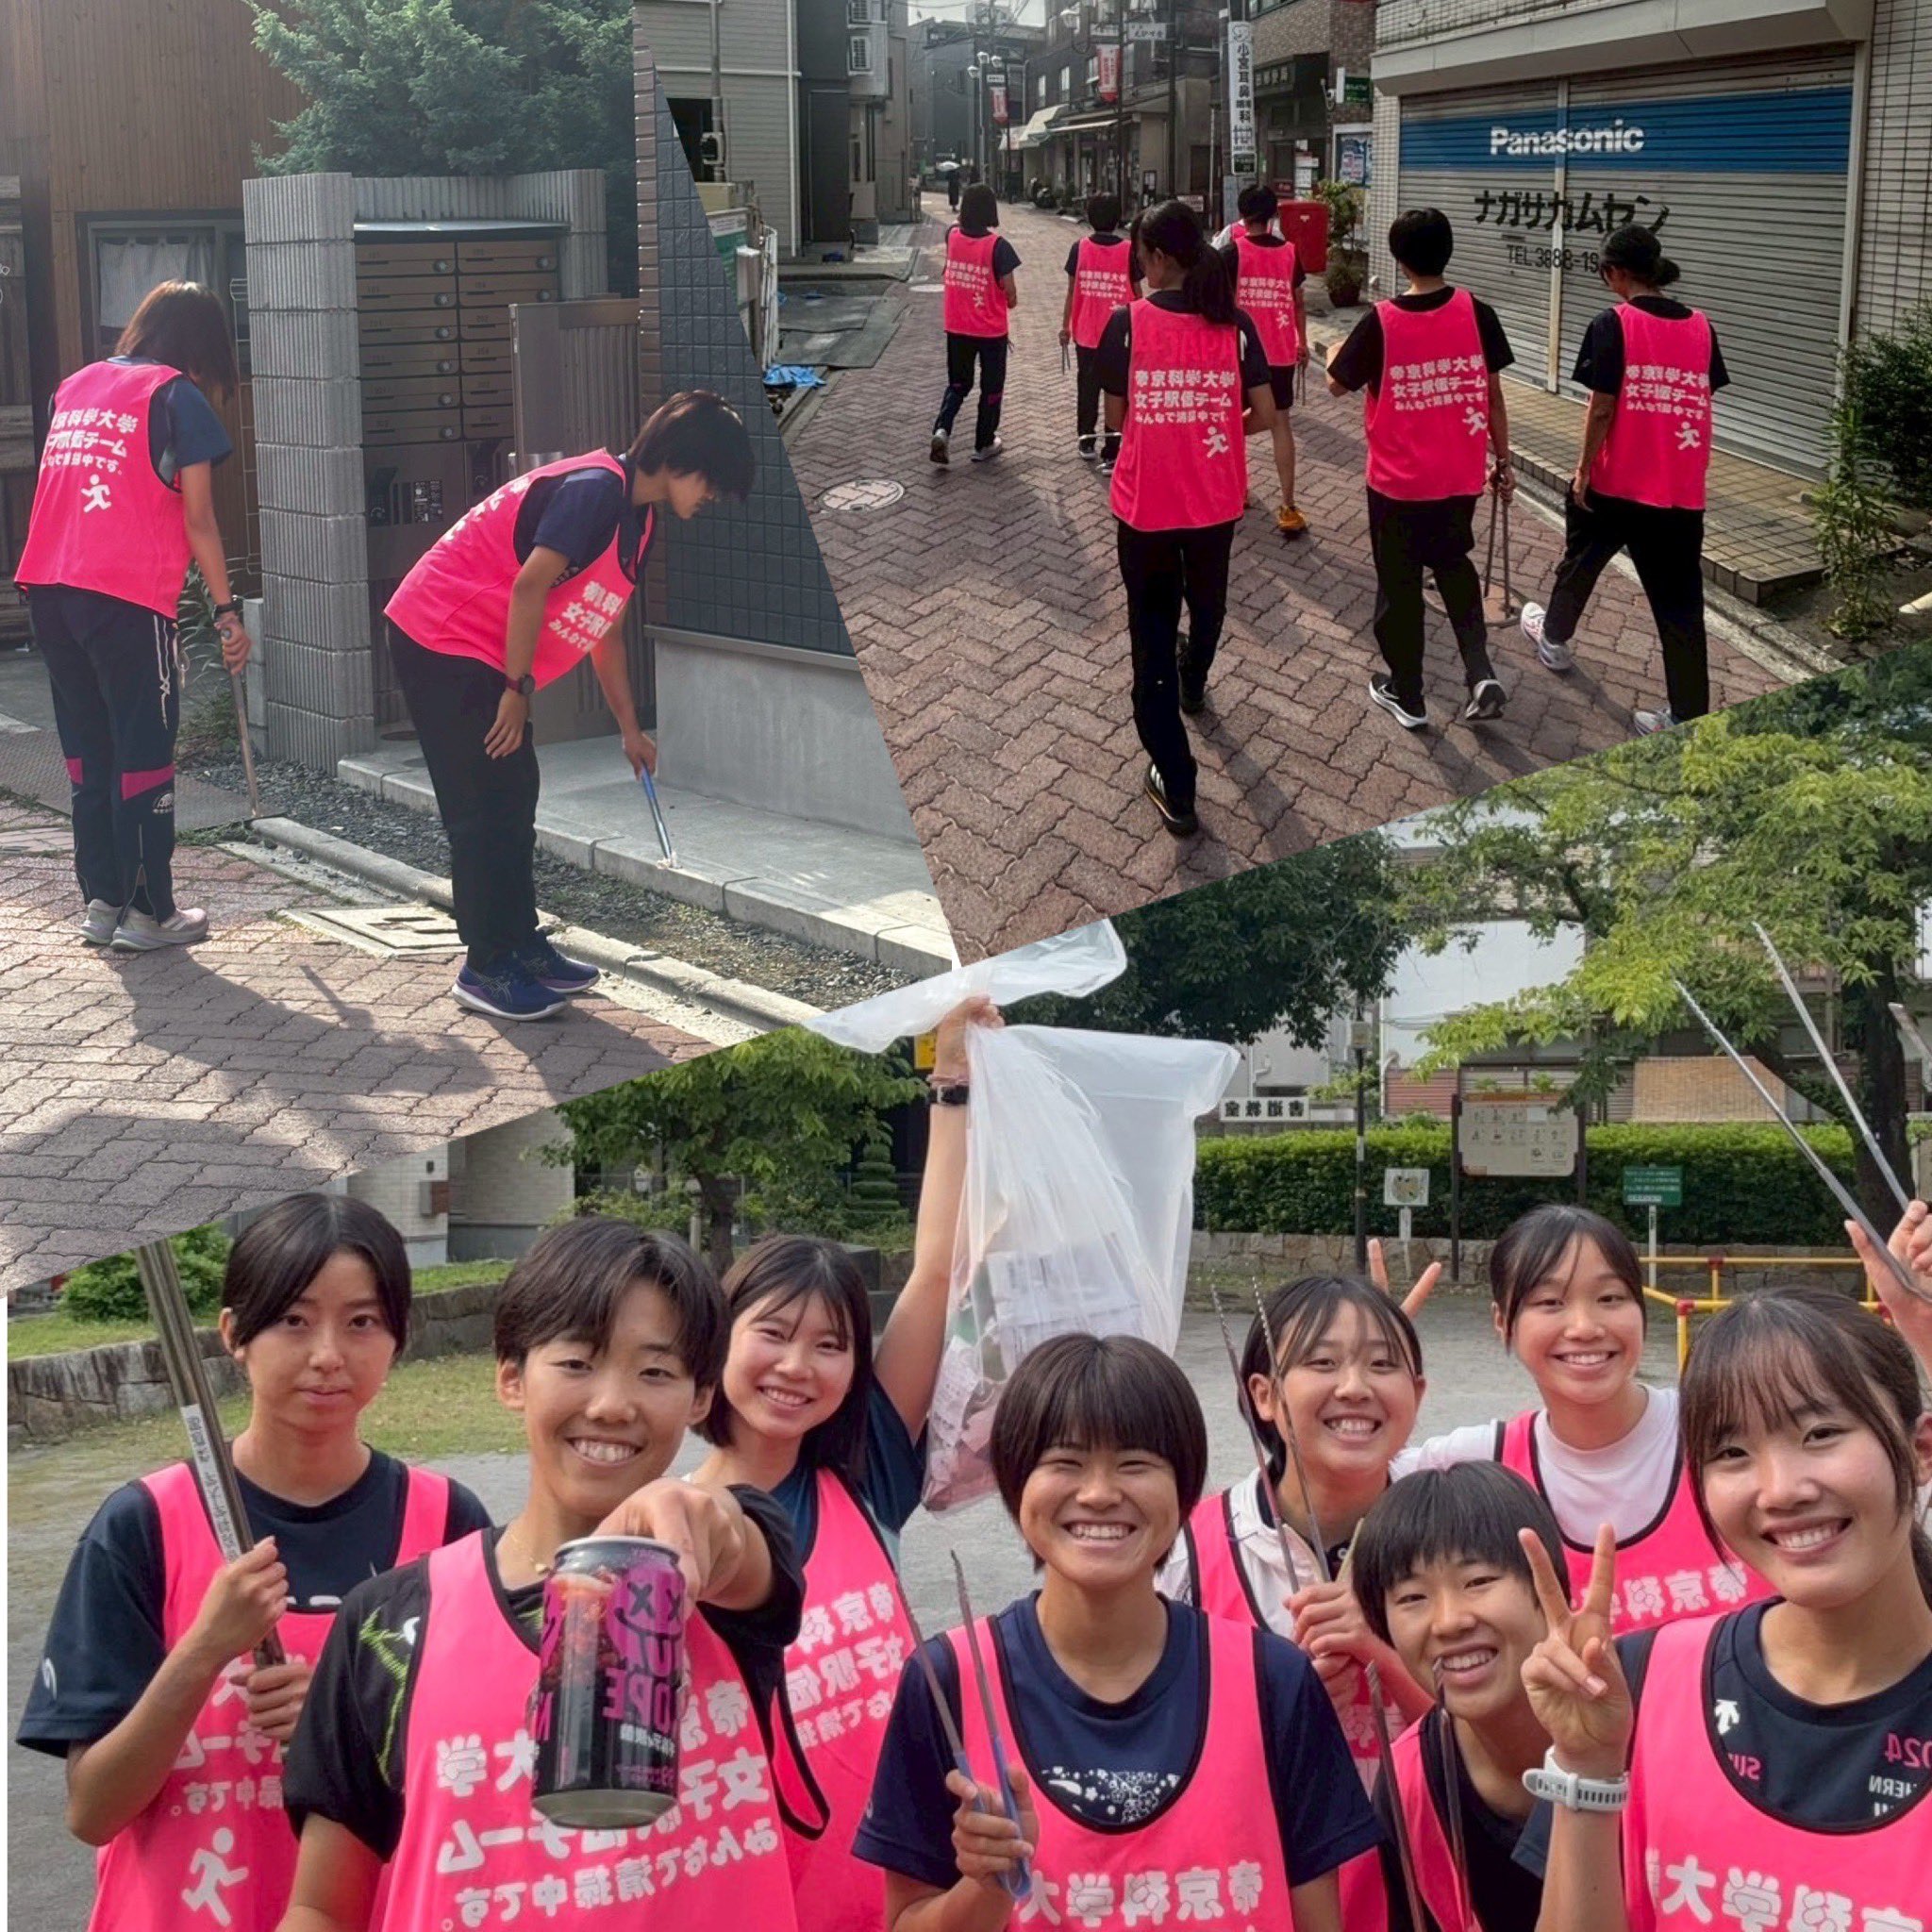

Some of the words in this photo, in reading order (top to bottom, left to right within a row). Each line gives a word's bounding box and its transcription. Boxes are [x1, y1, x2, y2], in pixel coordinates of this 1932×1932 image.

[1491, 119, 1645, 156] Panasonic
[1474, 190, 1670, 234] ナガサカムセン
[1535, 247, 1600, 274] 3888-19
[1135, 369, 1236, 388] 帝京科学大学
[1390, 354, 1483, 380] 帝京科学大学
[1625, 364, 1708, 389] 帝京科学大学
[1134, 390, 1233, 408] 女子駅伝チーム
[1391, 375, 1487, 398] 女子駅伝チーム
[1625, 382, 1707, 408] 女子駅伝チーム
[54, 408, 139, 433] 京科学大学
